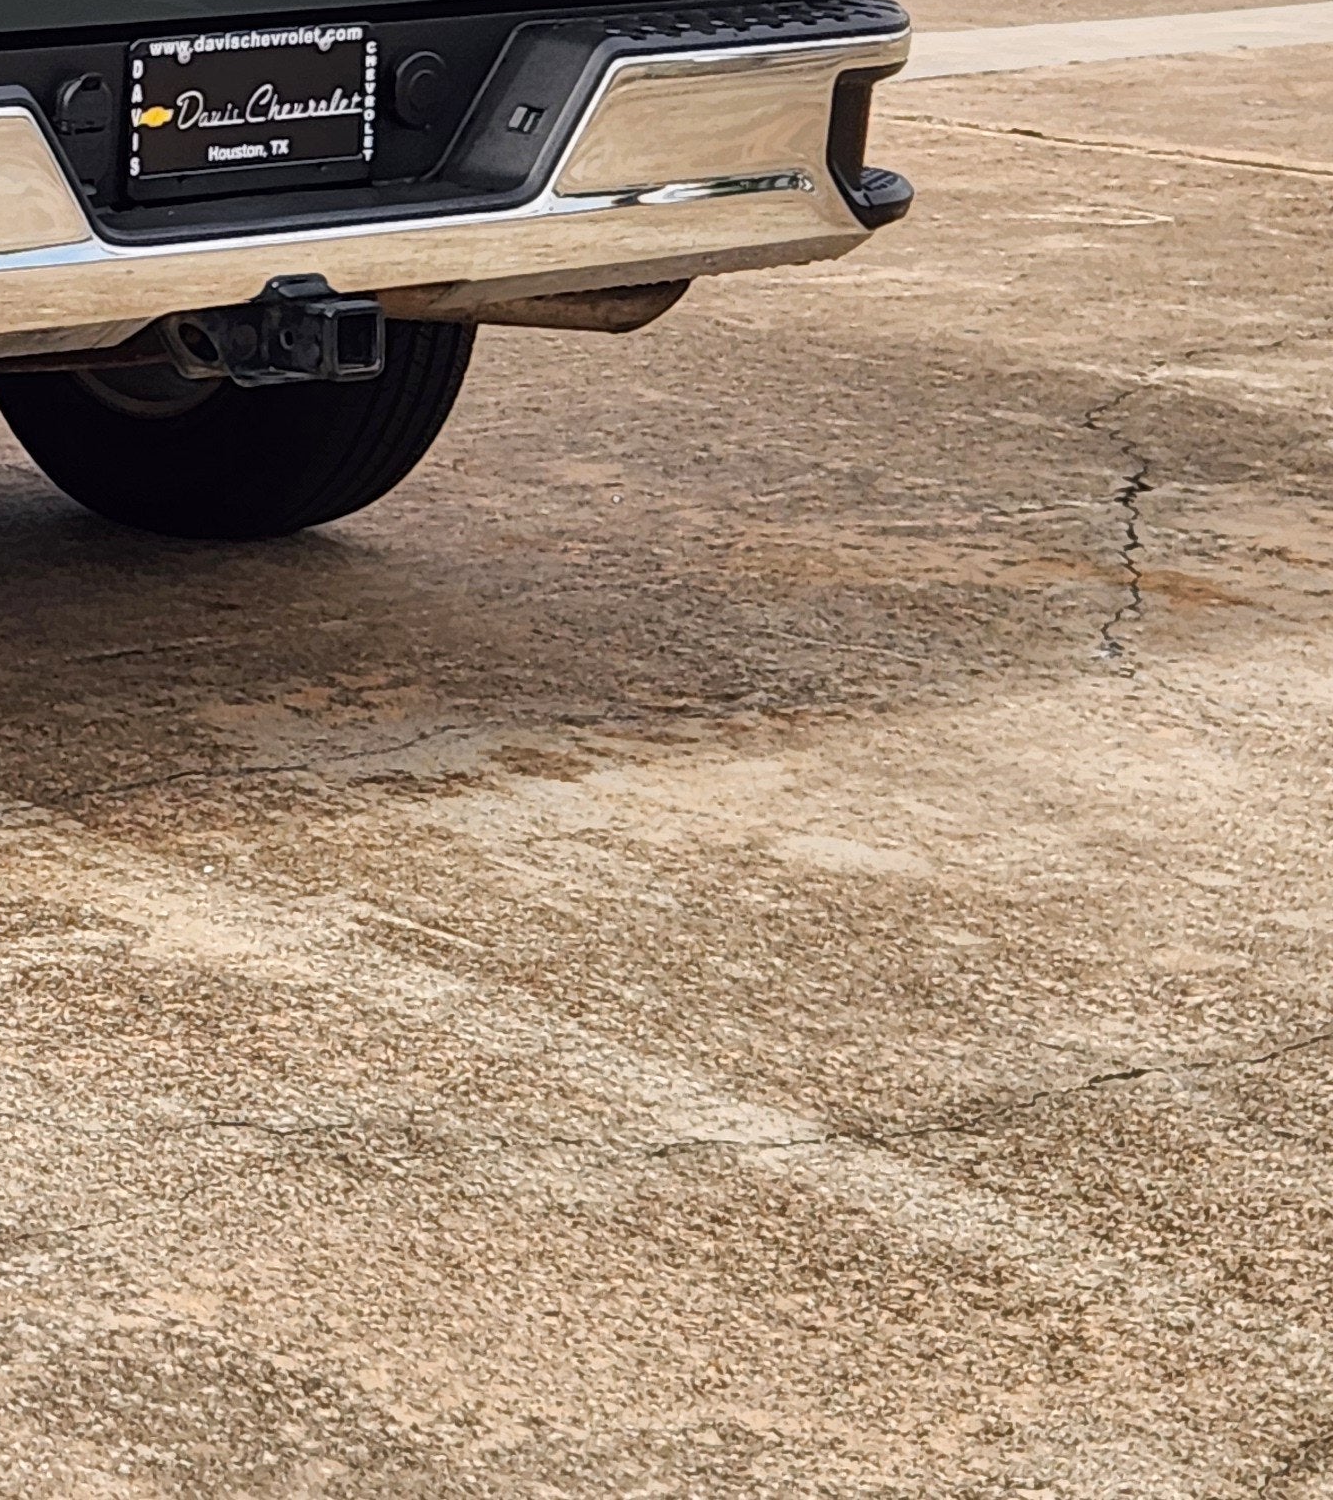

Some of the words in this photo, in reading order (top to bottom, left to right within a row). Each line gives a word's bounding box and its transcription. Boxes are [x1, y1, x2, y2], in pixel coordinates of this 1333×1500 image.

[149, 26, 363, 56] www.davischevrolet.com
[129, 58, 145, 177] DAVIS
[176, 90, 246, 131] Davis
[245, 83, 364, 124] Chevrolet
[362, 40, 378, 162] CHEVROLET
[207, 142, 269, 162] Houston,
[269, 138, 291, 156] TX
